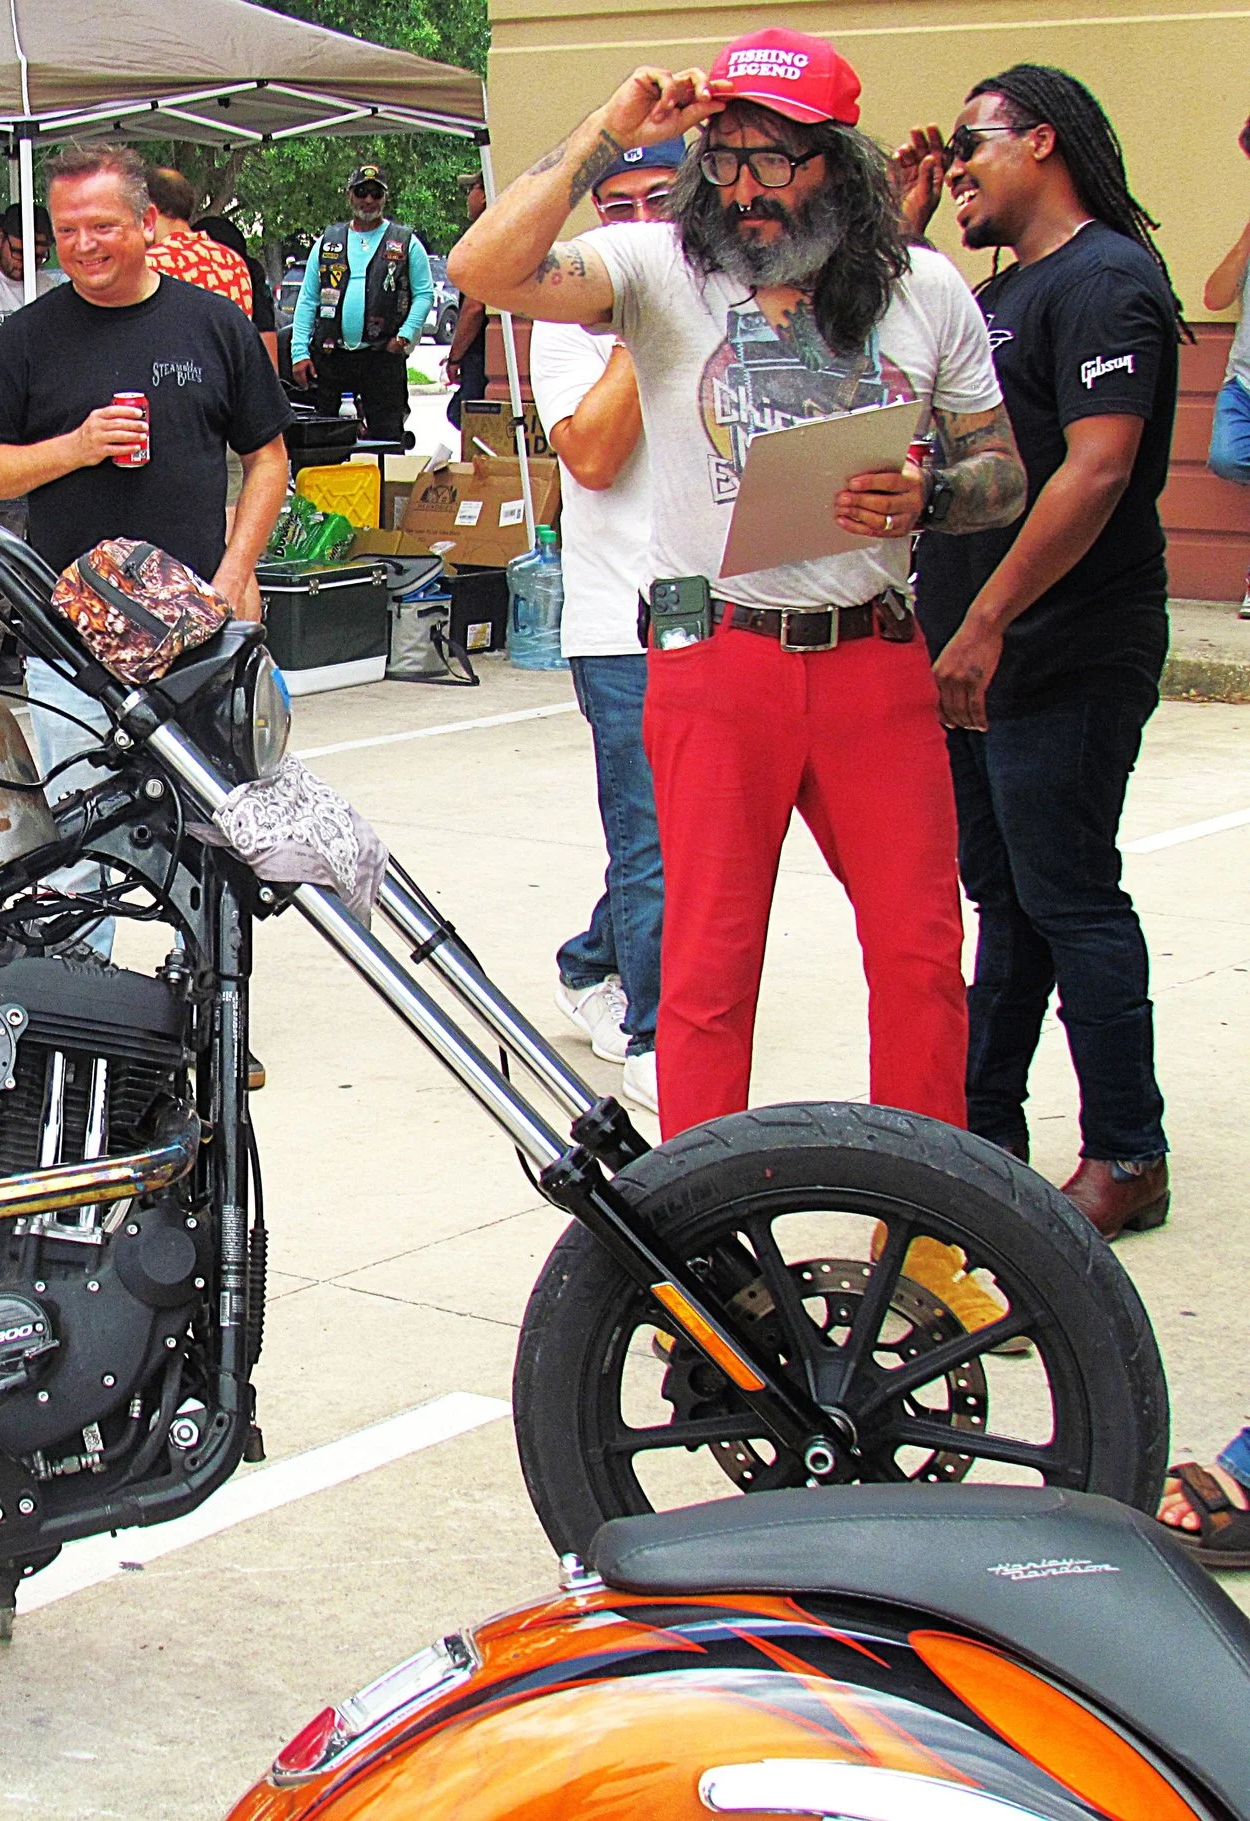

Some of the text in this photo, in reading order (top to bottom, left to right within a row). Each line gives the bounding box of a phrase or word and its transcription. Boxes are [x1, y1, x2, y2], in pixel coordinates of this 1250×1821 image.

[728, 49, 809, 67] FISHING
[727, 62, 801, 80] LEGEND
[1081, 354, 1135, 389] Gibson
[987, 1558, 1092, 1577] Harley
[1011, 1563, 1121, 1581] Davidson
